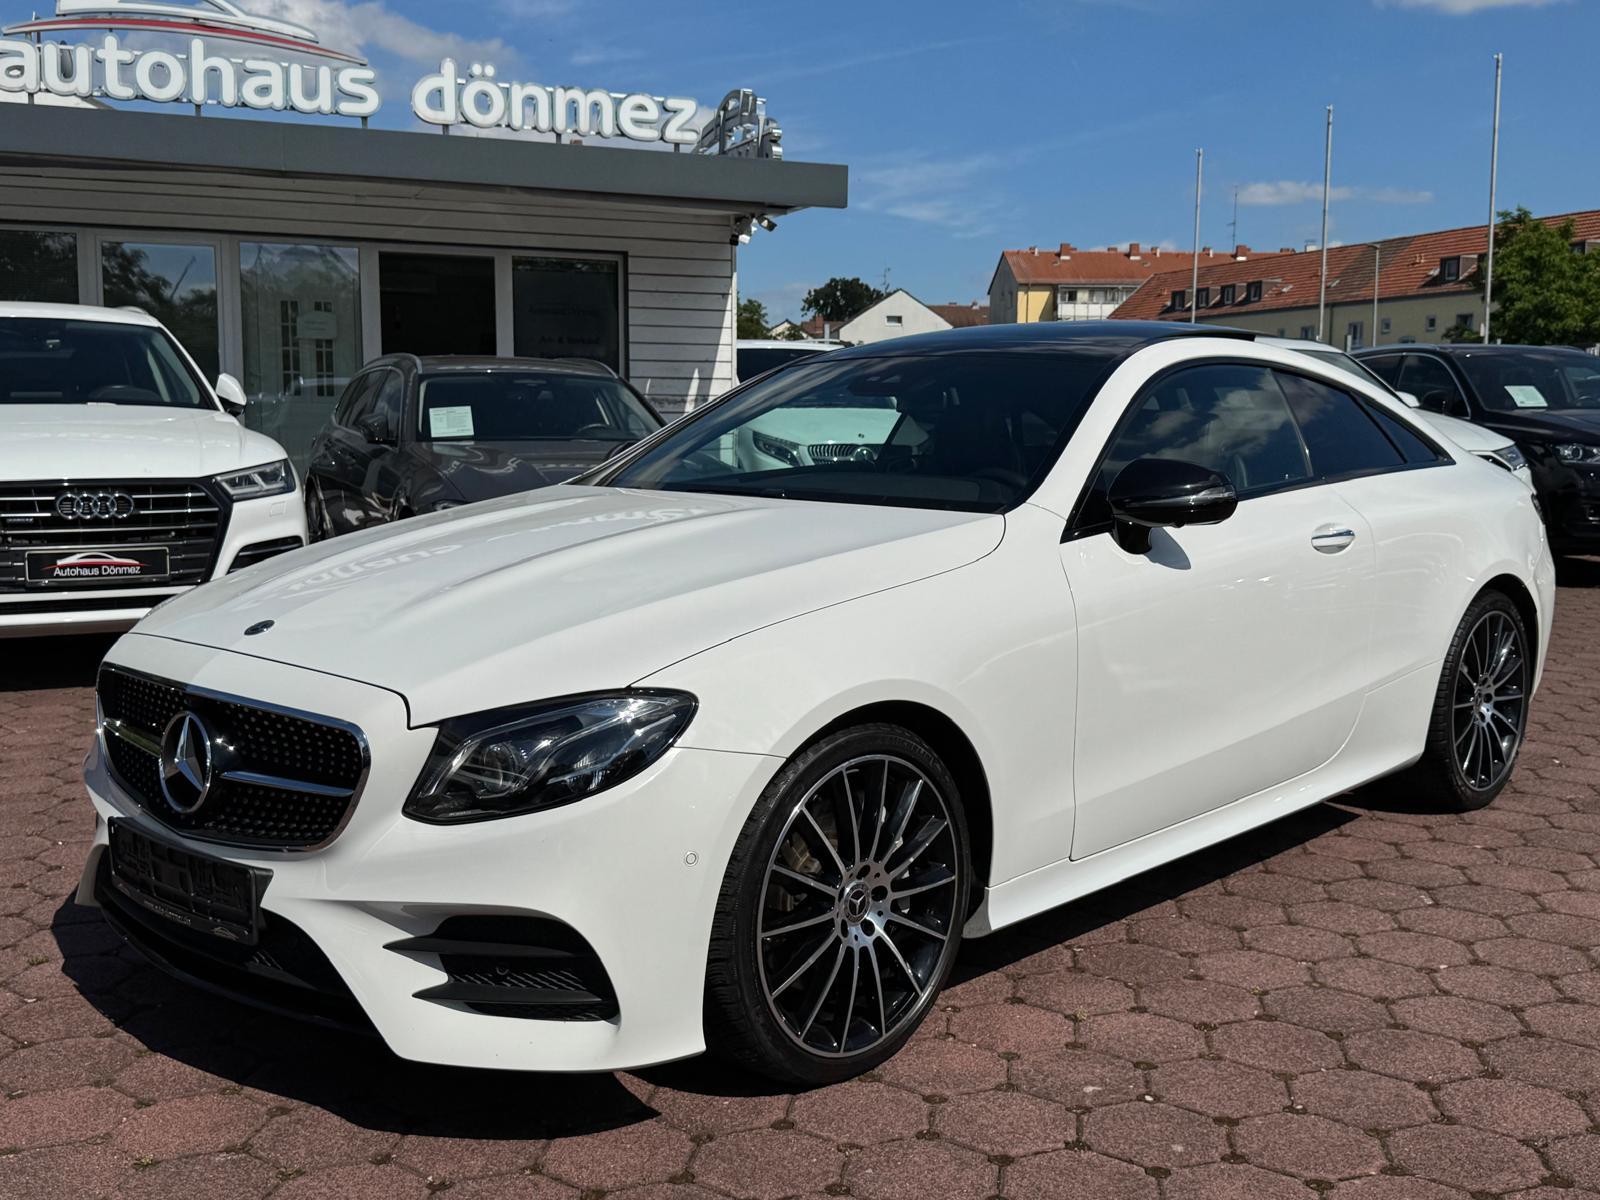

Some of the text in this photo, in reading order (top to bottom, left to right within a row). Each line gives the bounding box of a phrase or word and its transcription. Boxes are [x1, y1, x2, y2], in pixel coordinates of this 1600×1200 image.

[0, 34, 699, 144] autohaus dönmez
[53, 565, 142, 577] Autohaus Dönmez
